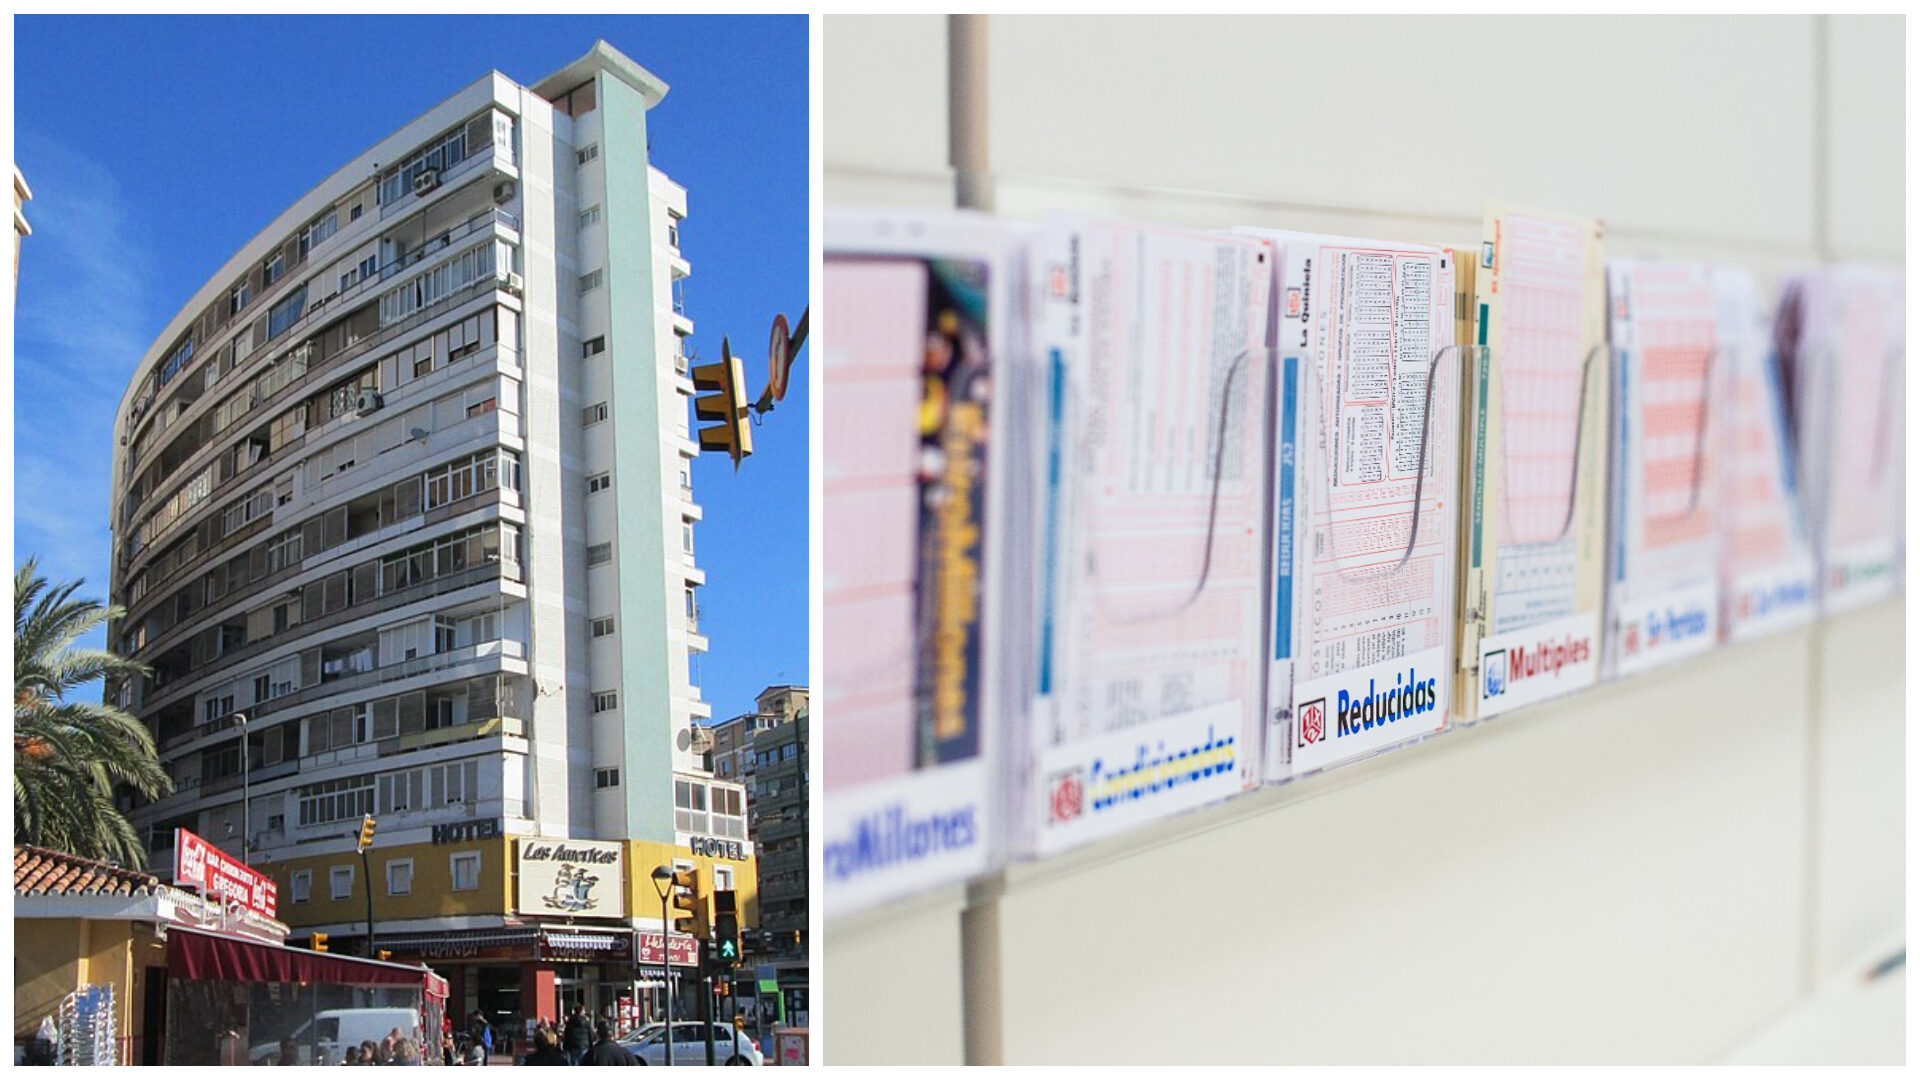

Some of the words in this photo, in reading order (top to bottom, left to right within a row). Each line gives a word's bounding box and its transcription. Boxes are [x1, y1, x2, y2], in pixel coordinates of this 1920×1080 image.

[1301, 258, 1312, 325] Quiniela
[1300, 332, 1308, 348] La
[1509, 633, 1590, 683] Multiples
[1337, 667, 1436, 738] Reducidas
[1092, 724, 1236, 811] Condicionadas
[432, 817, 503, 845] HOTEL
[690, 836, 748, 861] HOTEL
[523, 842, 552, 861] Las
